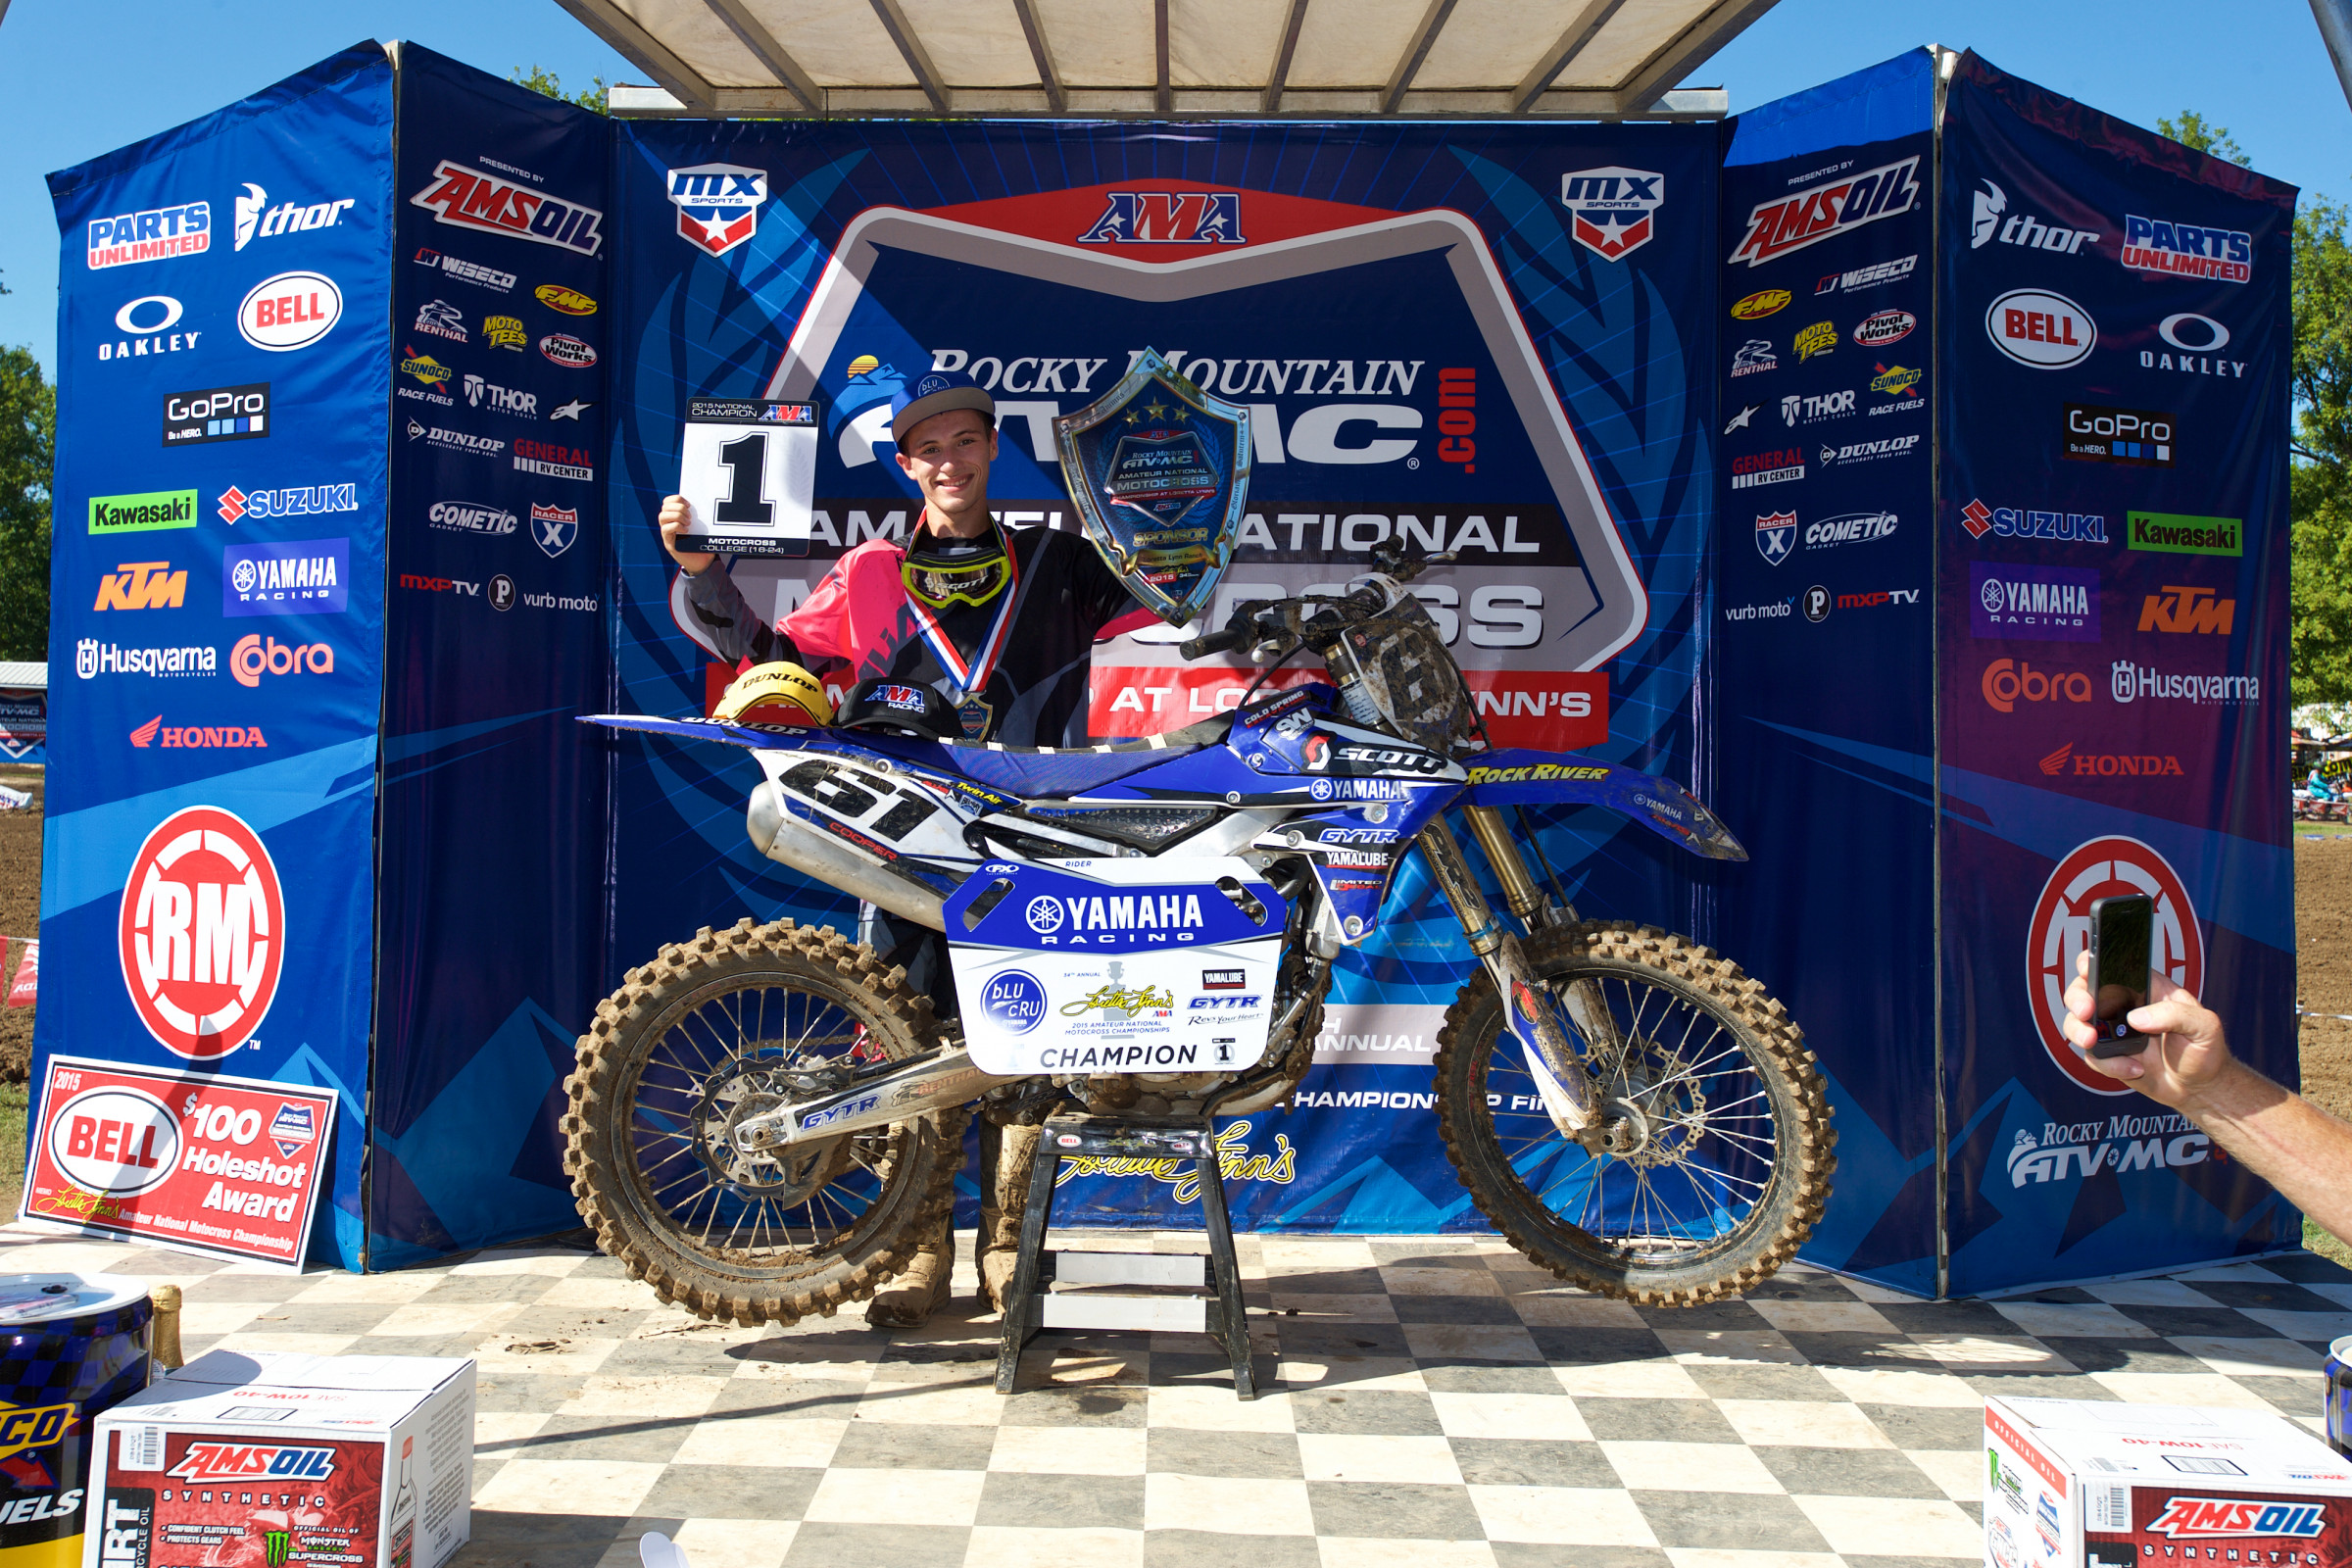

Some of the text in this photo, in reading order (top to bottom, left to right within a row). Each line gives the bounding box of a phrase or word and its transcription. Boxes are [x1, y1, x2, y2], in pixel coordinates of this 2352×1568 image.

[480, 156, 545, 183] PRESENTED BY
[1788, 160, 1854, 185] PRESENTED BY
[417, 164, 601, 254] AMSOIL
[1078, 193, 1247, 244] AMA
[1734, 159, 1917, 265] AMSOIL
[90, 204, 209, 249] PARTS
[2126, 215, 2251, 263] PARTS
[90, 233, 209, 268] UNLIMITED
[2122, 247, 2250, 283] UNLIMITED
[256, 293, 325, 328] BELL
[536, 286, 598, 312] FMF
[1732, 291, 1791, 318] FMF
[414, 322, 468, 343] RENTHAL
[484, 316, 522, 333] MOTO
[1794, 321, 1833, 345] MOTO
[1860, 322, 1910, 340] Works
[1866, 314, 1903, 330] Pivot
[2005, 308, 2079, 347] BELL
[99, 332, 199, 360] OAKLEY
[489, 330, 527, 348] TEES
[551, 337, 587, 353] Pivot
[1800, 333, 1838, 360] TEES
[545, 345, 592, 363] Works
[2140, 351, 2245, 378] OAKLEY
[403, 361, 451, 380] SUNOCO
[931, 349, 1107, 392] ROCKY
[1731, 362, 1778, 377] RENTHAL
[1873, 370, 1920, 391] SUNOCO
[169, 393, 265, 420] GoPro
[398, 387, 454, 407] RACE FUELS
[487, 384, 537, 415] THOR
[1804, 390, 1855, 417] THOR
[1869, 398, 1925, 416] RACE FUELS
[692, 409, 758, 417] CHAMPION
[759, 405, 813, 422] AMA
[2069, 410, 2171, 441] GoPro
[427, 426, 505, 452] DUNLOP
[1838, 435, 1920, 459] DUNLOP
[2084, 444, 2107, 455] HERO.
[514, 438, 593, 466] GENERAL
[1733, 447, 1805, 474] GENERAL
[540, 464, 588, 479] RV CENTER
[713, 431, 776, 526] 1
[1117, 476, 1209, 491] MOTOCROSS
[1118, 470, 1161, 480] AMATEUR
[1757, 467, 1800, 484] RV CENTER
[95, 497, 190, 526] Kawasaki
[249, 483, 355, 518] SUZUKI
[429, 503, 517, 534] COMETIC
[429, 522, 463, 533] GASKET
[535, 511, 573, 521] RACER
[1759, 518, 1793, 529] RACER
[1993, 508, 2105, 543] SUZUKI
[542, 522, 564, 547] X
[1133, 528, 1208, 547] SPONSOR
[1234, 514, 1540, 553] ATIONAL
[1766, 529, 1786, 555] X
[1805, 514, 1898, 545] COMETIC
[2134, 517, 2235, 550] Kawasaki
[258, 557, 336, 589] YAMAHA
[937, 575, 988, 590] SCOTT
[1150, 573, 1174, 582] 2015
[94, 562, 187, 611] KTM
[240, 590, 329, 601] RACING
[2006, 582, 2088, 614] YAMAHA
[523, 592, 598, 612] vurb moto
[1725, 601, 1791, 620] vurb moto
[2137, 585, 2235, 635] KTM
[1990, 614, 2083, 626] RACING
[100, 644, 216, 677] Husqvarna
[230, 634, 333, 686] Cobra
[742, 672, 818, 693] DUNLOP
[1982, 658, 2092, 712] Cobra
[2138, 667, 2260, 705] Husqvarna
[863, 684, 925, 708] AMA
[887, 702, 924, 713] RACING
[1109, 689, 1169, 711] AT
[1245, 709, 1269, 724] COLD
[1270, 690, 1304, 710] SPRING
[161, 726, 268, 748] HONDA
[1334, 748, 1442, 768] SCOTT
[2074, 755, 2184, 776] HONDA
[1469, 763, 1610, 785] ROCK RIVER
[778, 760, 940, 843] 61
[956, 782, 985, 797] Twin
[983, 794, 1003, 805] Air
[1333, 780, 1401, 799] YAMAHA
[1645, 798, 1682, 820] YAMAHA
[829, 822, 898, 861] COOPER
[1318, 828, 1400, 844] GYTR
[1326, 852, 1388, 866] YAMALUBE
[1066, 894, 1203, 930] YAMAHA
[153, 880, 247, 986] RM
[1041, 932, 1194, 945] RACING
[1204, 972, 1245, 983] YAMALUBE
[1187, 995, 1261, 1009] GYTR
[1040, 1044, 1198, 1068] CHAMPION
[55, 1071, 80, 1091] 2015
[801, 1095, 880, 1132] GYTR
[67, 1115, 158, 1169] BELL
[2042, 1122, 2104, 1147] ROCKY
[182, 1147, 307, 1188] Holeshot
[202, 1182, 299, 1223] Award
[119, 1210, 293, 1252] Amateur National Motocross Championship
[172, 1444, 334, 1480] AMSOIL
[1994, 1420, 2056, 1483] OFFICIAL OIL
[162, 1490, 325, 1508] SYNTHETIC
[139, 1507, 150, 1526] OIL
[2151, 1498, 2324, 1536] AMSOIL
[167, 1535, 222, 1545] PROTECTS GEARS
[168, 1525, 245, 1536] CONFIDENT CLUTCH FEEL
[288, 1551, 364, 1563] SUPERCROSS
[2143, 1544, 2319, 1565] SYNTHETIC
